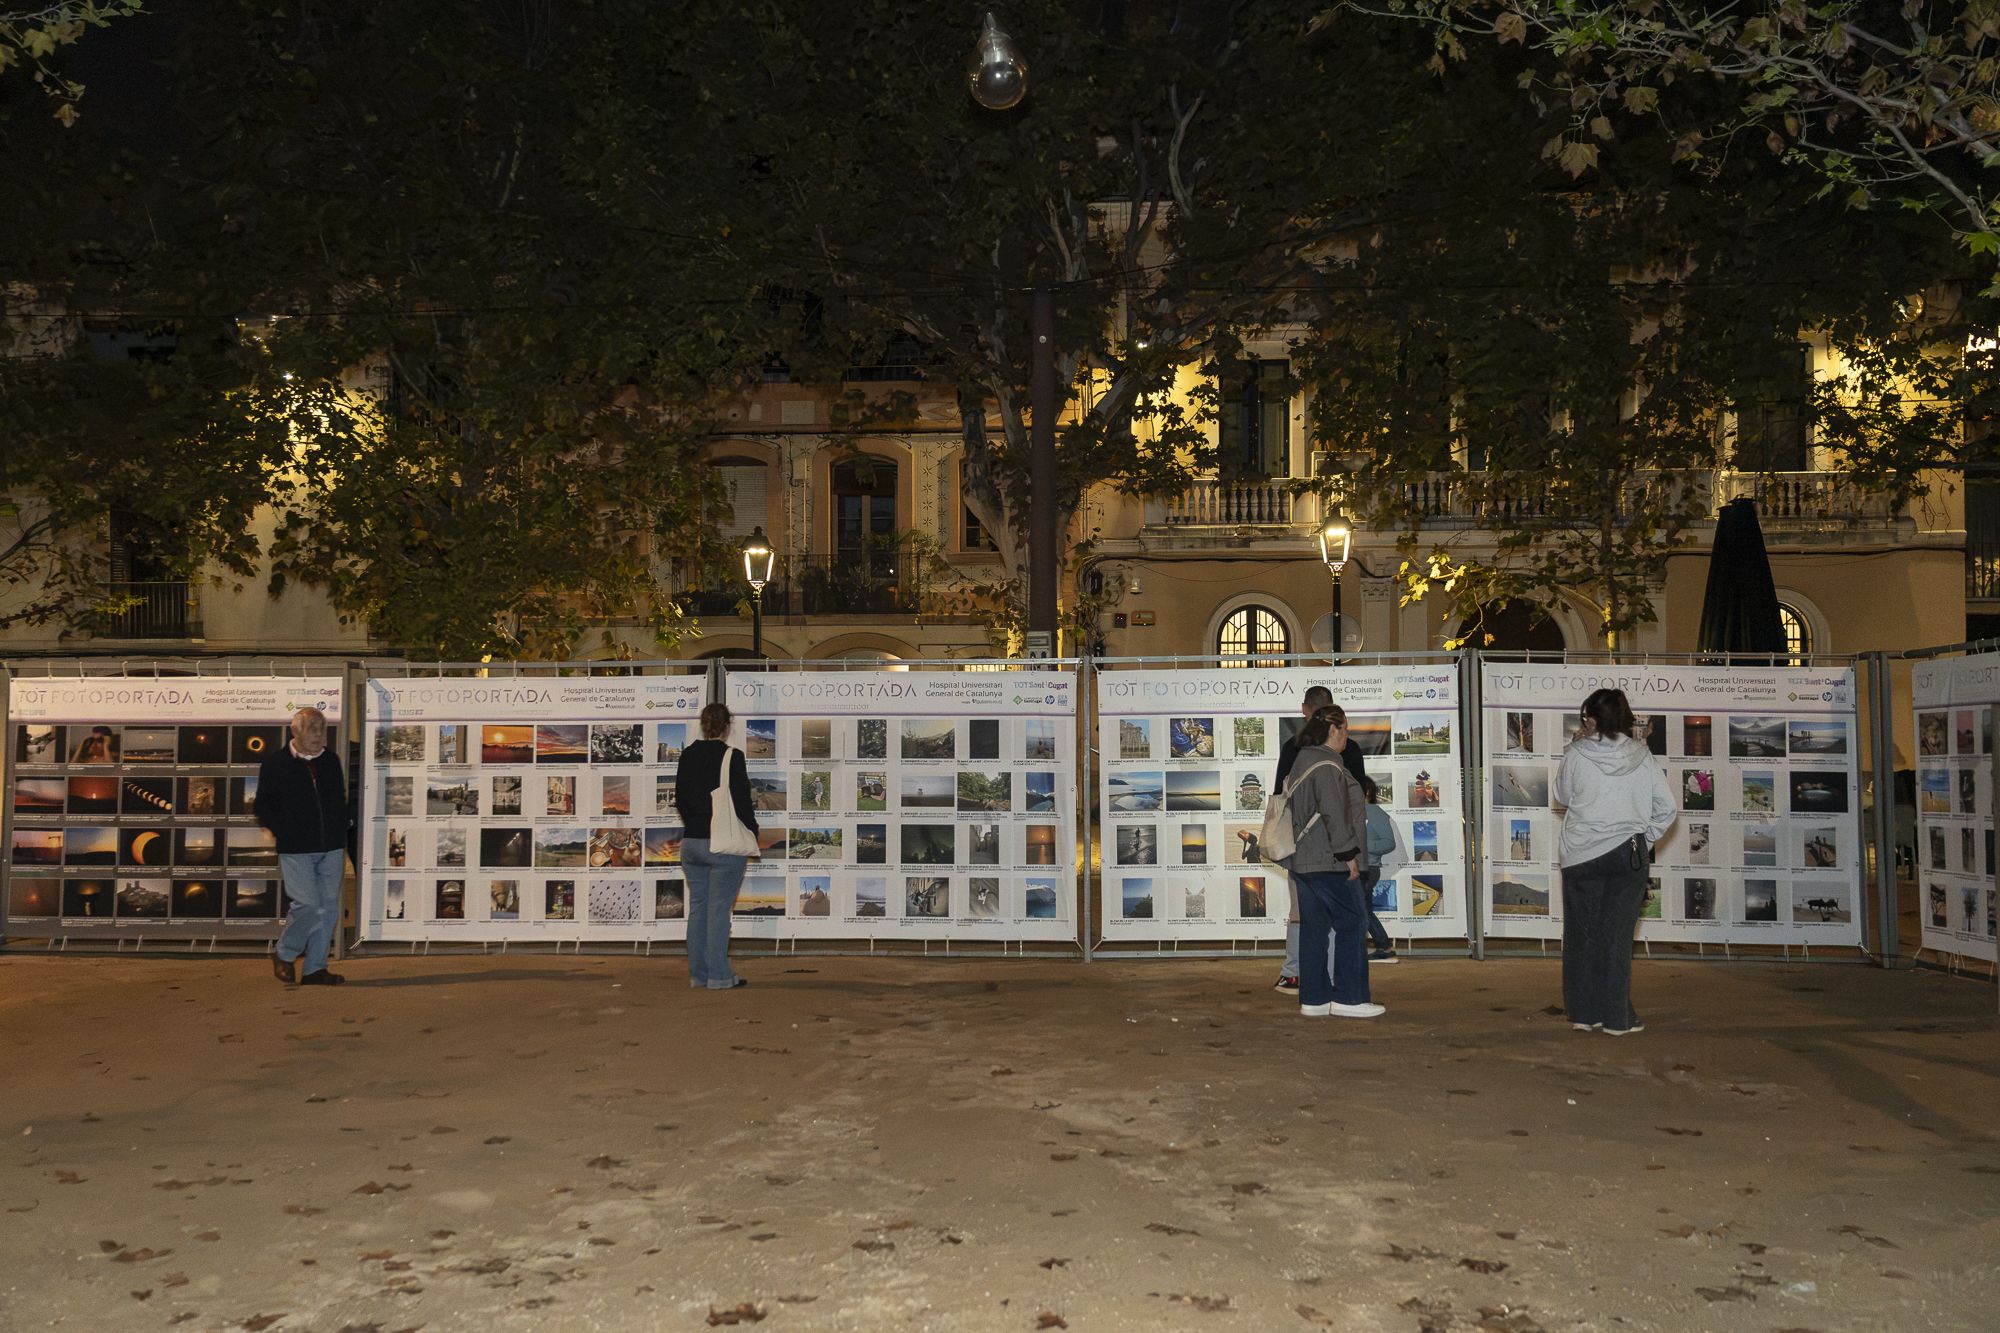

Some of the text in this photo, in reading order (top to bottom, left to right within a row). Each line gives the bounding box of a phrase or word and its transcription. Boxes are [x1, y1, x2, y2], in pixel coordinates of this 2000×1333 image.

[1306, 678, 1338, 686] Hospital
[1428, 675, 1450, 684] Cugat
[1698, 677, 1776, 685] Hospital Universitari
[1824, 678, 1845, 687] Cugat
[929, 681, 1003, 689] Hospital Universitari
[1048, 681, 1068, 690] Cugat
[1492, 675, 1685, 693] TOT FOTOPORTADA
[205, 689, 235, 697] Hospital
[564, 687, 593, 695] Hospital
[735, 683, 917, 699] TOT FOTOPORTADA
[1106, 682, 1137, 696] TOT
[1143, 681, 1294, 697] FOTOPORTADA
[1345, 686, 1382, 694] Catalunya
[1738, 686, 1776, 694] Catalunya
[18, 690, 194, 705] TOT FOTOPORTADA
[377, 689, 552, 704] TOT FOTOPORTADA
[926, 690, 954, 698] General
[966, 690, 1003, 698] Catalunya
[240, 697, 276, 705] Catalunya
[600, 696, 635, 704] Catalunya
